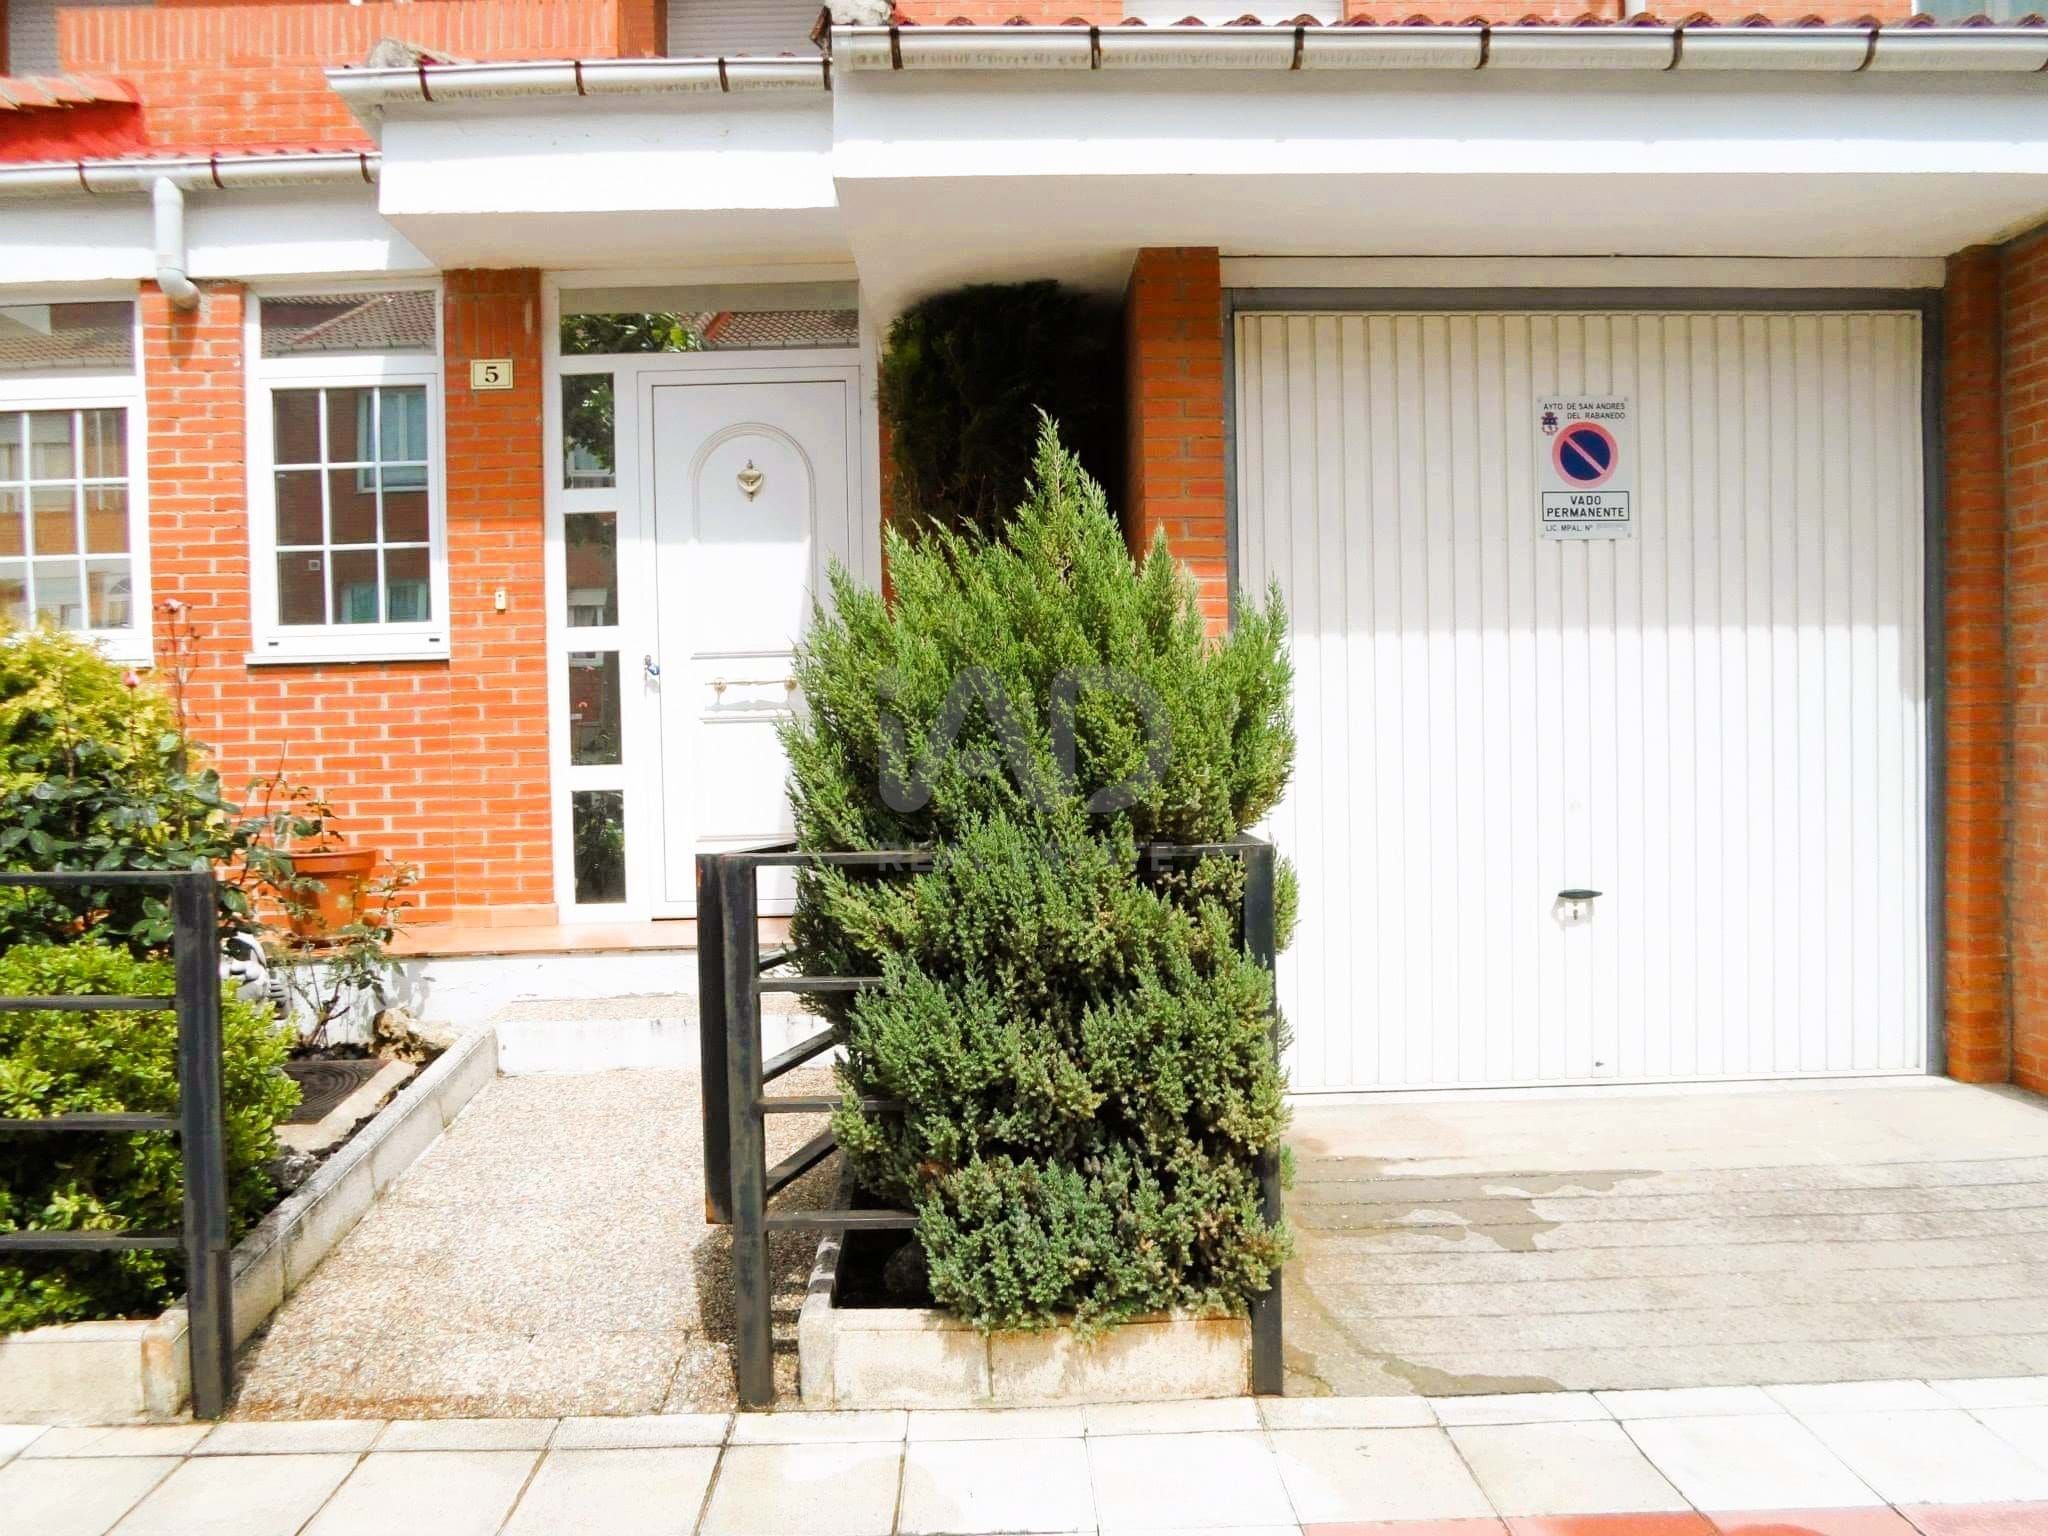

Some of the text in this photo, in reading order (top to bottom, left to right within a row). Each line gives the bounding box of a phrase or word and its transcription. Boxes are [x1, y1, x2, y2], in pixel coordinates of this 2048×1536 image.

[485, 366, 499, 383] 5
[1567, 412, 1581, 420] DEL
[1570, 495, 1602, 505] VADO
[1546, 507, 1625, 518] PERMANENTE
